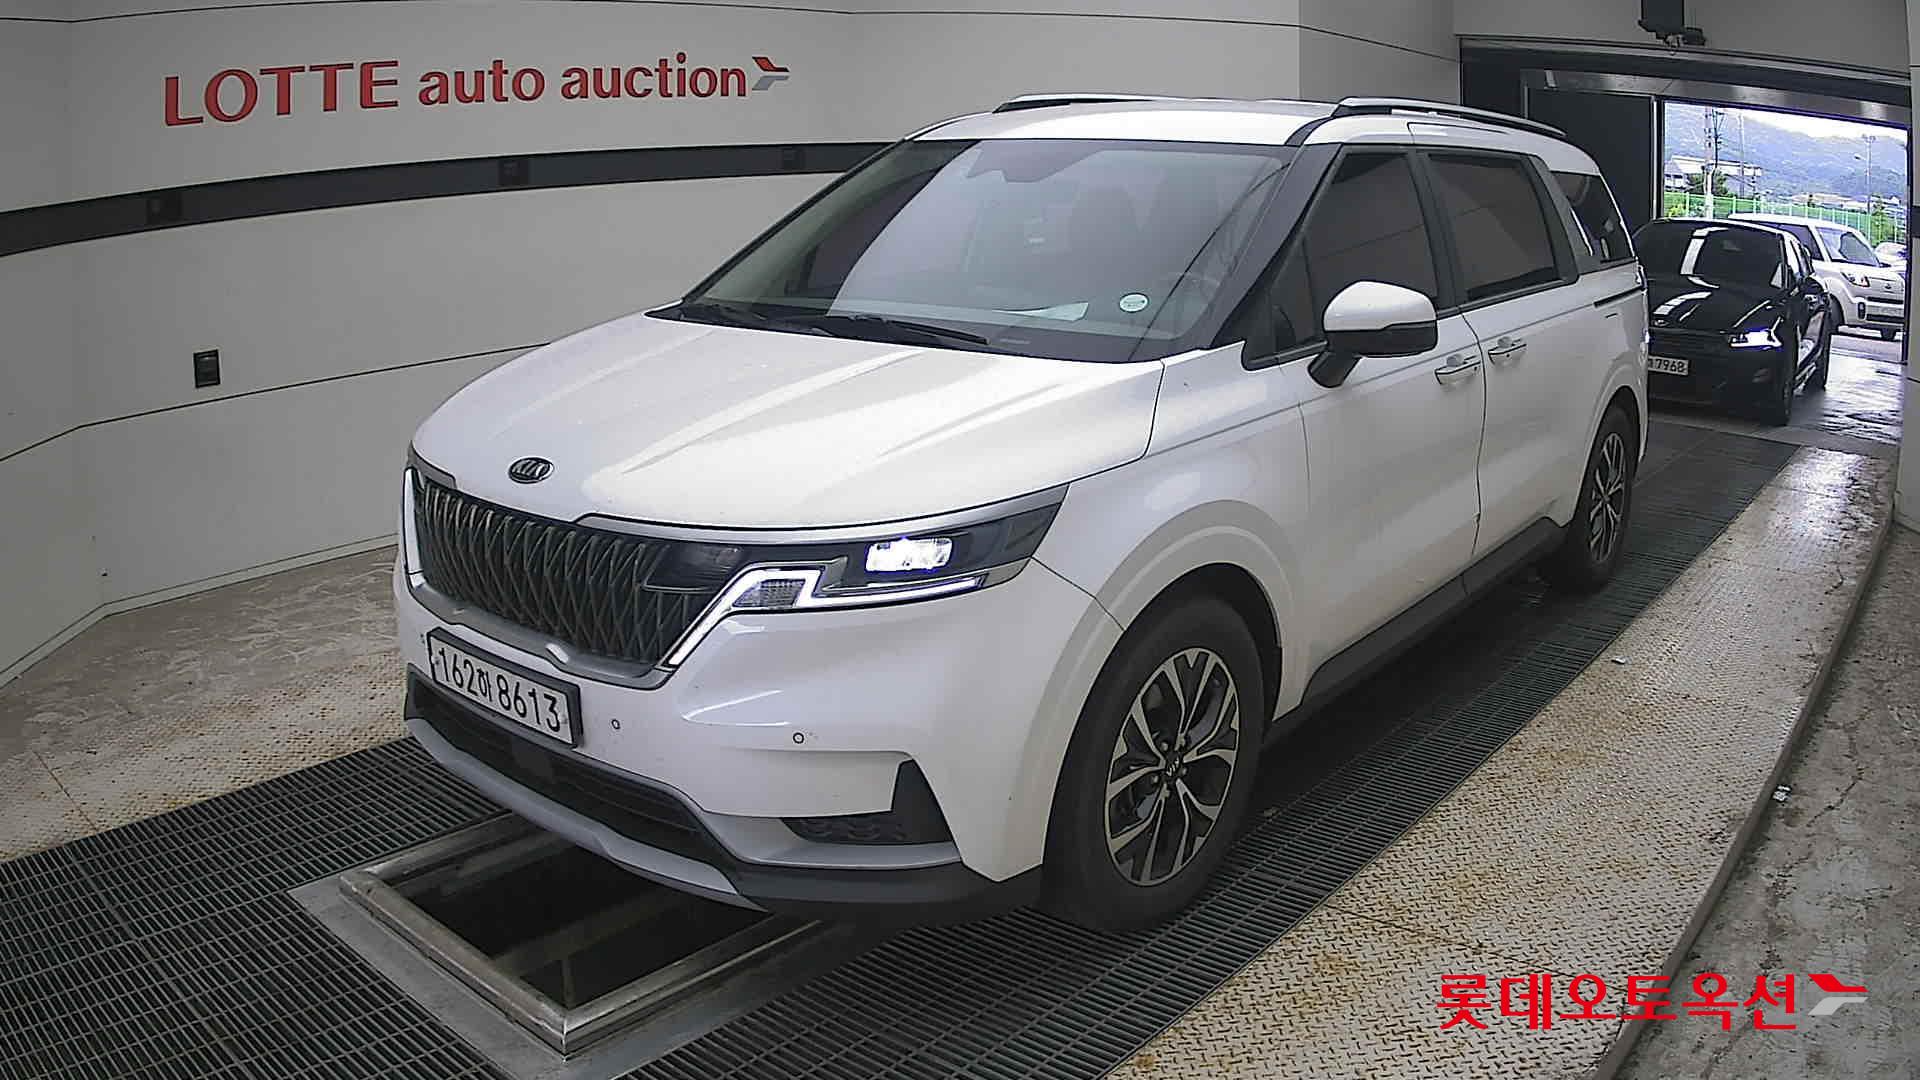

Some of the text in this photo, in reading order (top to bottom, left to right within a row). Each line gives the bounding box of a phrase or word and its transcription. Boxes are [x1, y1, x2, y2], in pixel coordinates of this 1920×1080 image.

[164, 52, 748, 127] LOTTE auto auction
[496, 673, 560, 733] 8613
